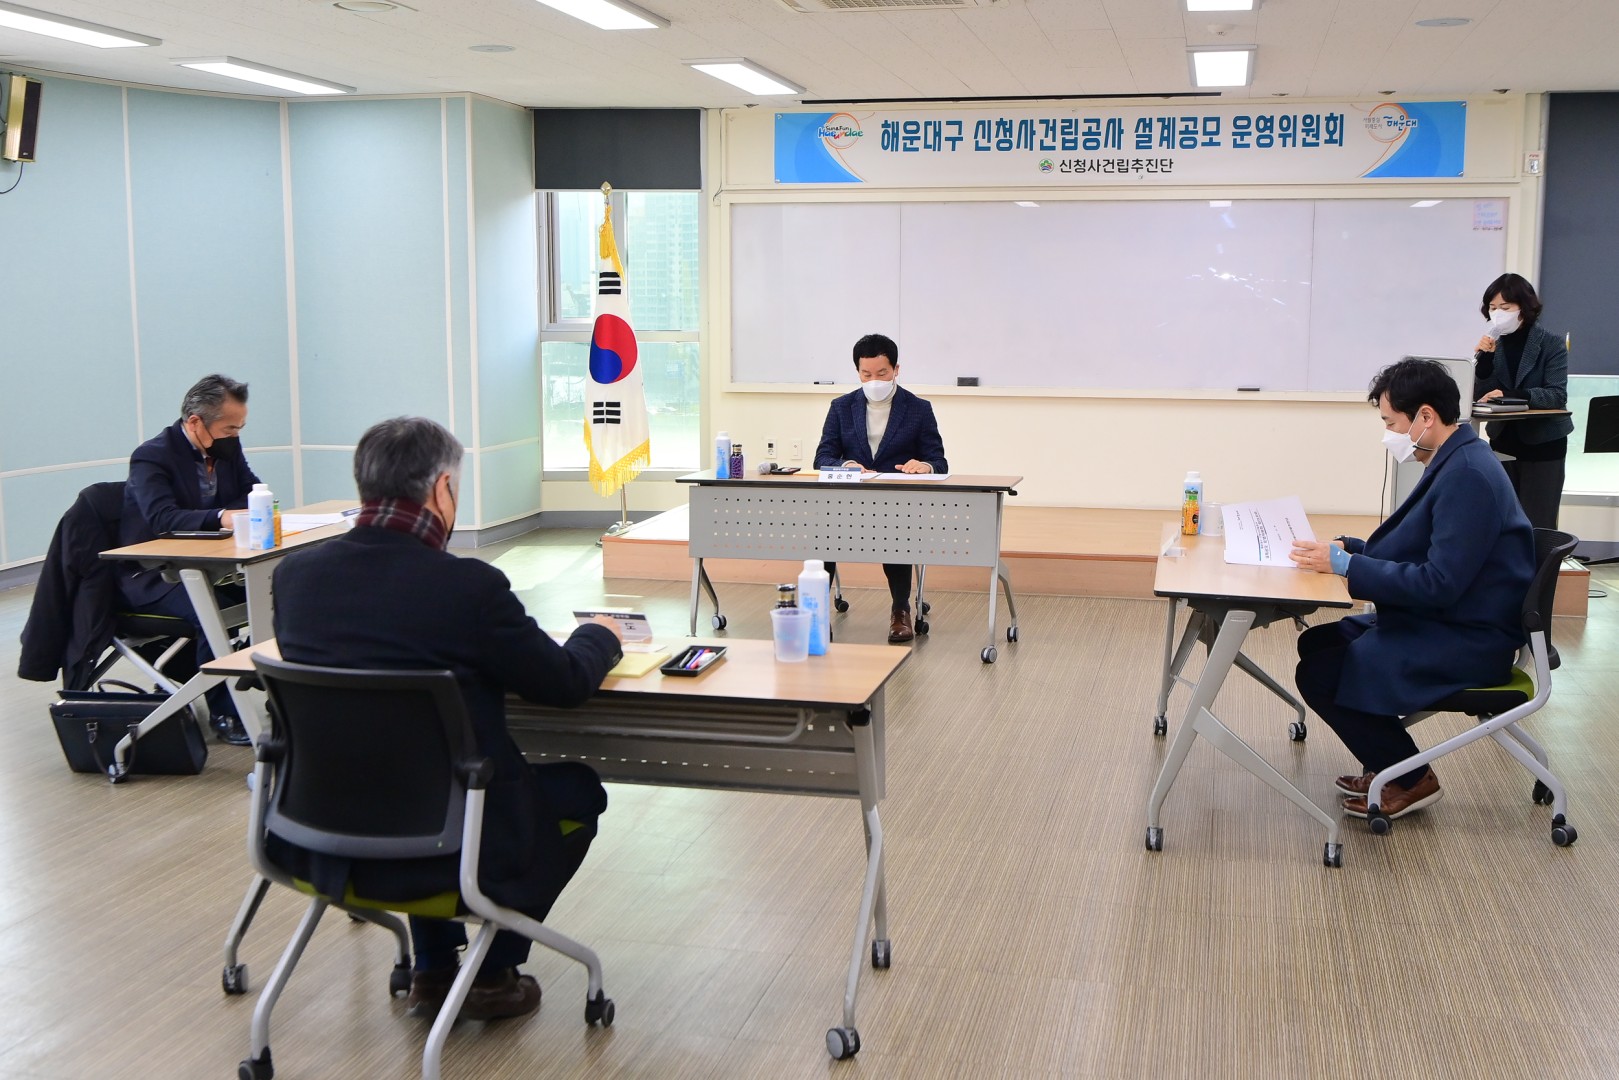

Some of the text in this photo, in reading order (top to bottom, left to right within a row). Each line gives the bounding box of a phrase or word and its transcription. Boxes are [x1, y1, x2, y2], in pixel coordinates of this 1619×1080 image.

[1382, 114, 1417, 131] 해운대
[880, 112, 1345, 152] 해운대구 신청사건립공사 설계공모 운영위원회
[1059, 158, 1174, 174] 신청사건립추진단
